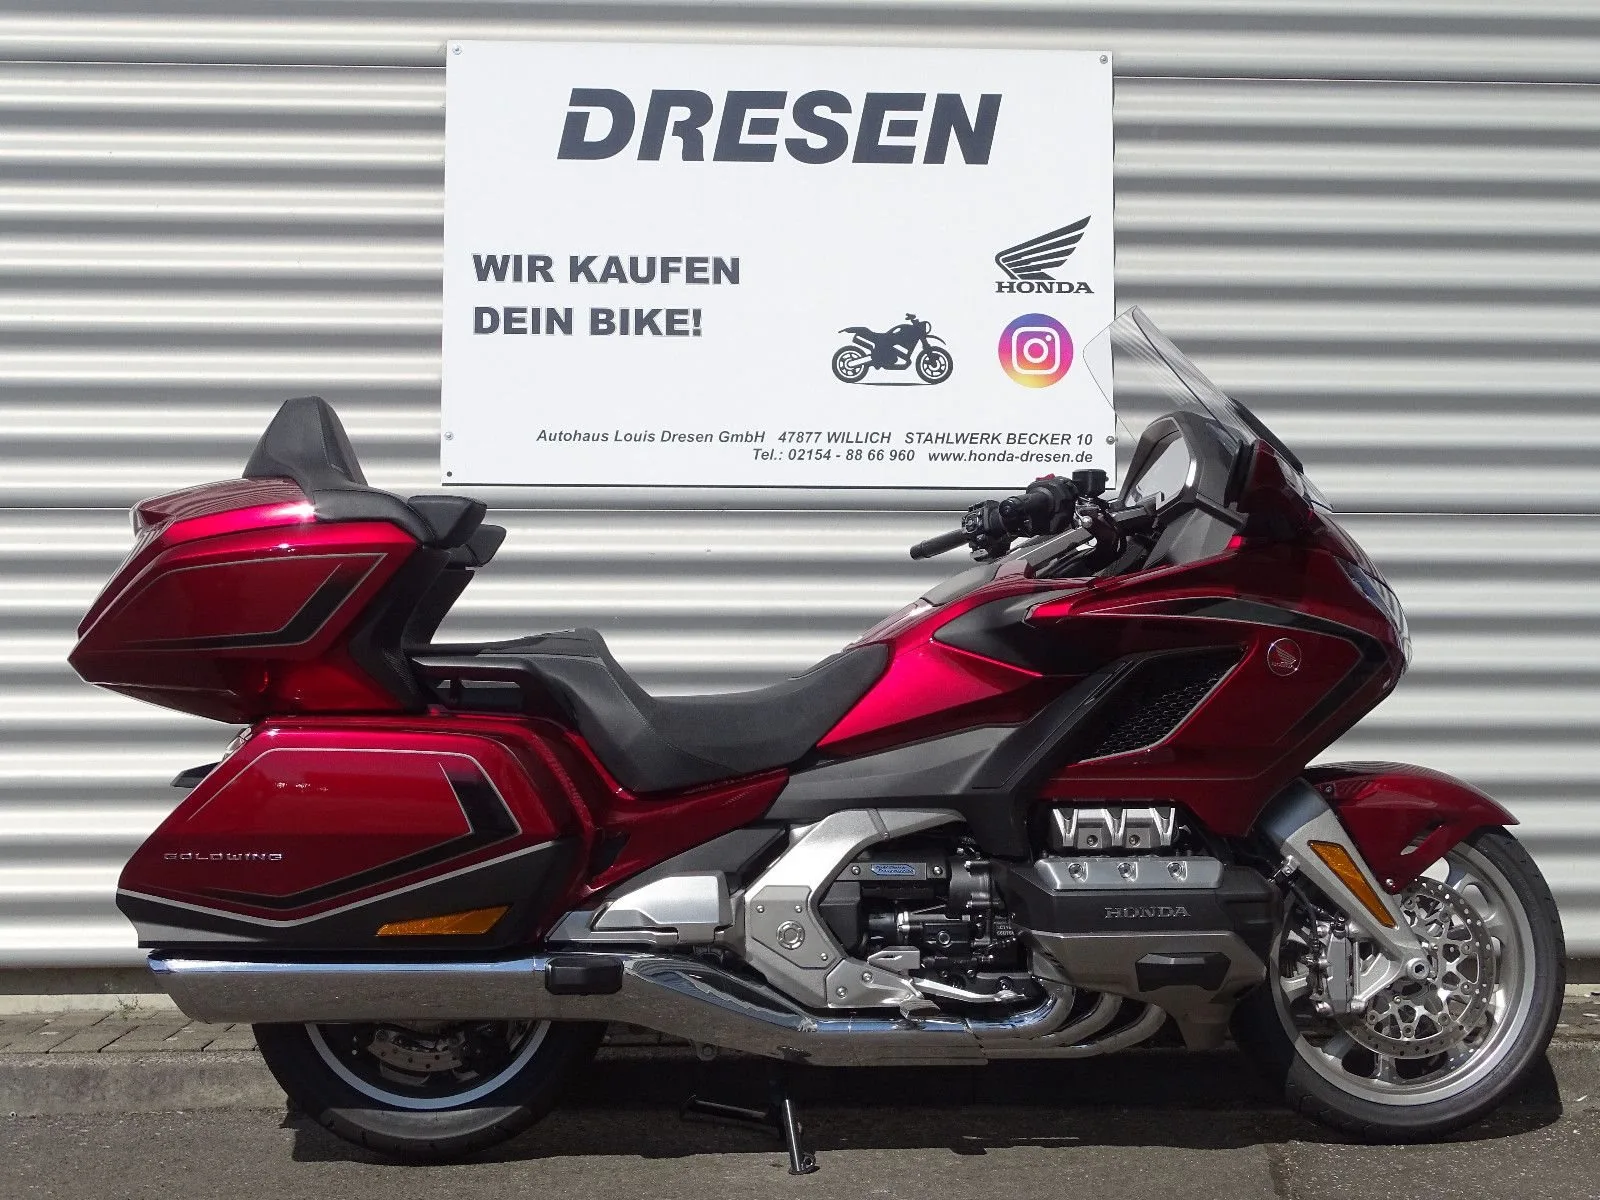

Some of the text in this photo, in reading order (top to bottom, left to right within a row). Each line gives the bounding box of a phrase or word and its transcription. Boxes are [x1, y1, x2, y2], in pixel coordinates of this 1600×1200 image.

[557, 88, 1003, 166] DRESEN
[471, 253, 741, 286] WIR KAUFEN
[995, 281, 1094, 294] HONDA
[472, 305, 703, 338] DEIN BIKE!
[536, 430, 1093, 446] Autohaus Louis Dresen GmbH 47877 WILLICH STAHLWERK BECKER 10
[752, 448, 784, 461] Tel.:
[787, 448, 832, 461] 02154
[845, 449, 863, 462] 88
[867, 449, 885, 462] 66
[888, 449, 916, 462] 960
[928, 449, 1093, 463] www.honda-dresen.de
[163, 853, 283, 861] GOLDWING
[1104, 906, 1191, 919] HONDA
